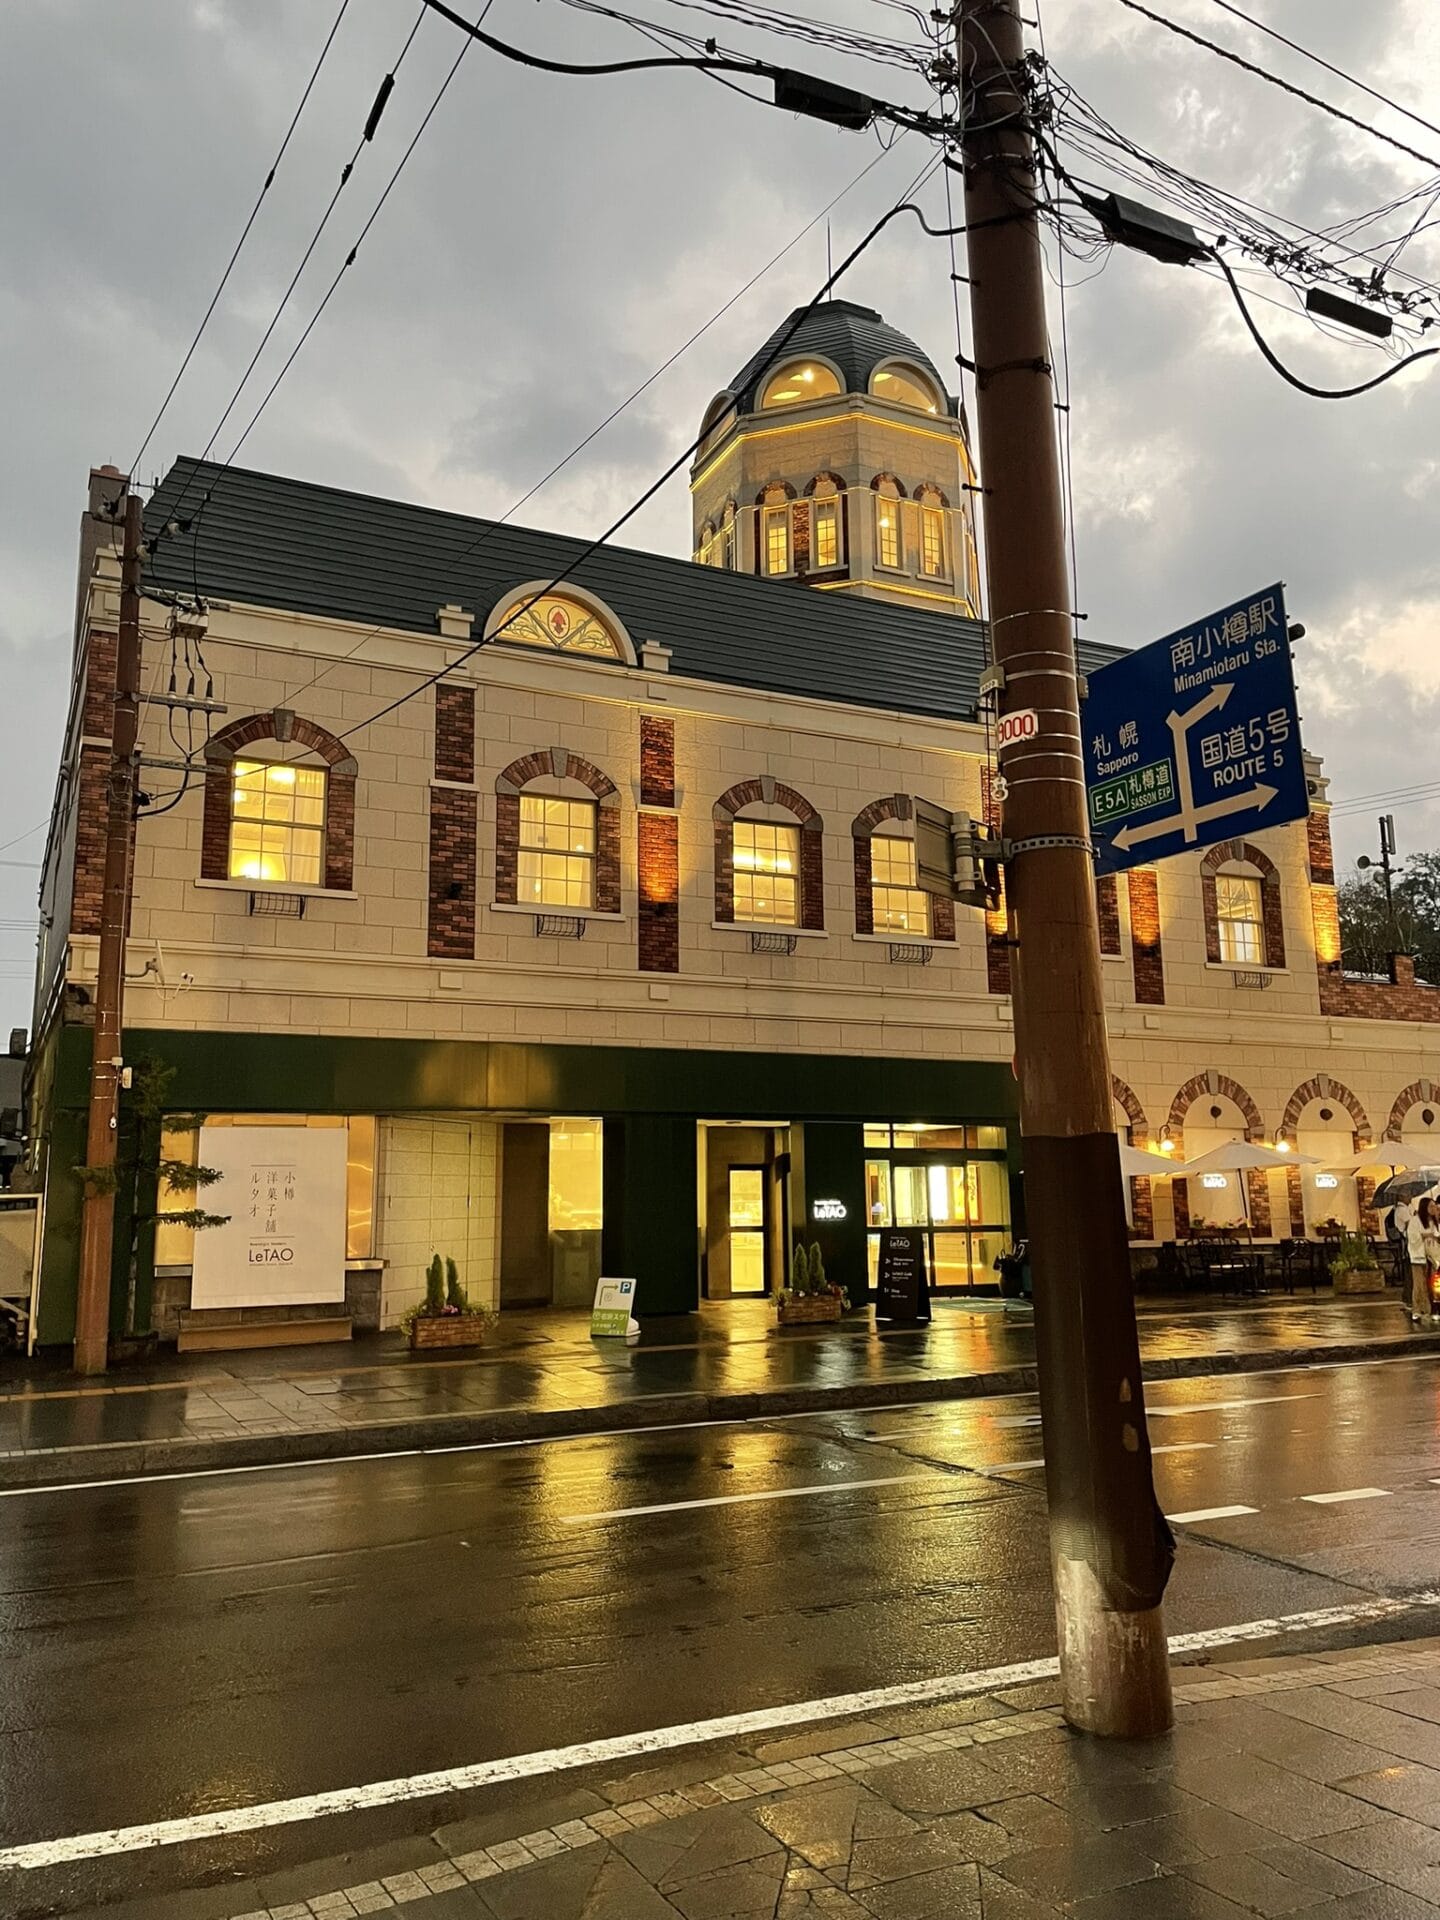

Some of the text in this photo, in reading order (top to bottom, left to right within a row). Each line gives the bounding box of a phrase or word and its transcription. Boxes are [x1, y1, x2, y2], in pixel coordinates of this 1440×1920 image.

[1169, 596, 1279, 673] 南小樽駅
[1174, 639, 1281, 694] Minamiotaru Sta.
[1200, 707, 1291, 769] 国道5号
[1096, 752, 1139, 776] Sapporo
[1128, 764, 1170, 796] 札樽道
[1213, 748, 1284, 788] ROUTE 5
[1095, 788, 1126, 813] E5A
[249, 1171, 263, 1218] ルタオ
[249, 1248, 294, 1262] LeTAO
